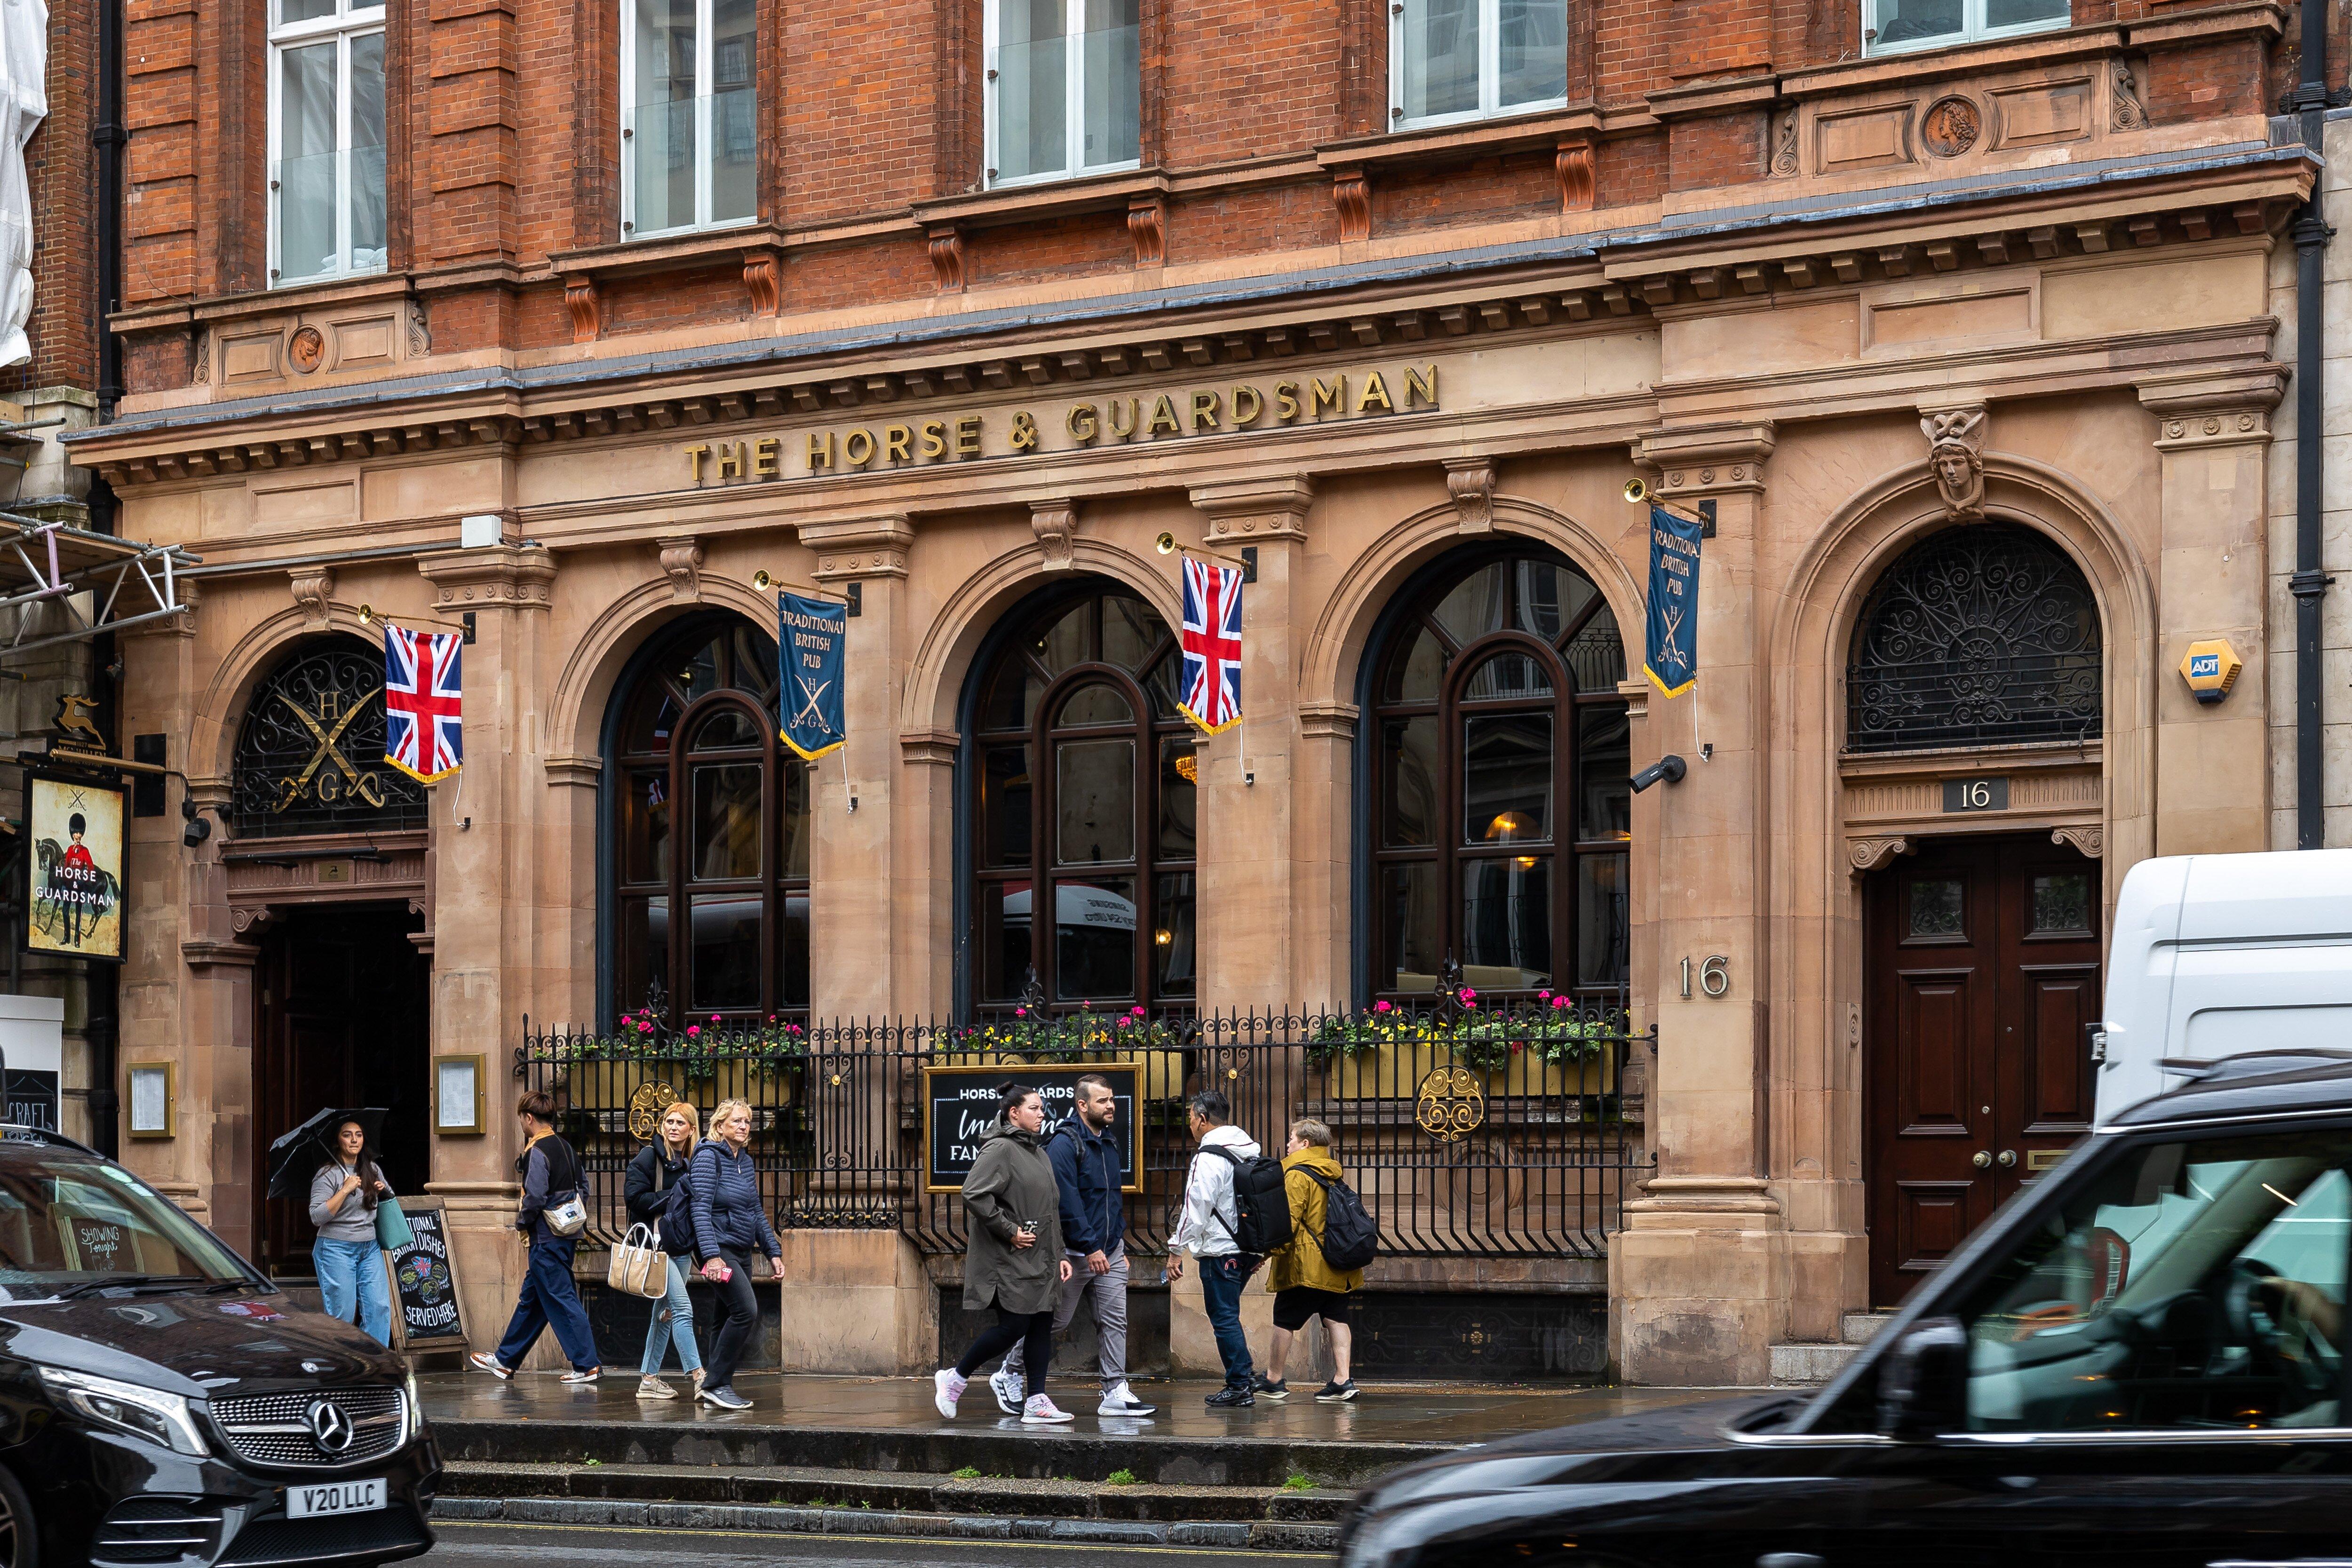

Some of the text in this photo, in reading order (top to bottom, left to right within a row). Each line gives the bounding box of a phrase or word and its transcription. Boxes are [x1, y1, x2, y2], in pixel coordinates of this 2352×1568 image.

[683, 364, 1438, 481] THE HORSE & GUARDSMAN
[1661, 554, 1689, 577] BRITISH
[1666, 578, 1682, 596] PUB
[1669, 605, 1678, 621] H
[795, 633, 830, 651] BRITISH
[803, 653, 821, 669] PUB
[2192, 659, 2218, 673] ADT
[807, 677, 816, 692] H
[318, 692, 341, 720] H
[808, 715, 816, 728] G
[318, 773, 339, 801] G
[1962, 781, 1990, 807] 16
[55, 866, 96, 882] HORSE
[35, 886, 114, 907] GUARDSMAN
[1680, 955, 1729, 996] 16
[1033, 1087, 1074, 1098] ARDS
[81, 1226, 119, 1242] SHOWING
[81, 1241, 118, 1258] Tonight
[417, 1232, 445, 1259] DISHES
[405, 1305, 438, 1327] SERVED
[437, 1300, 457, 1325] HERE
[303, 1483, 375, 1512] V20 LLC
